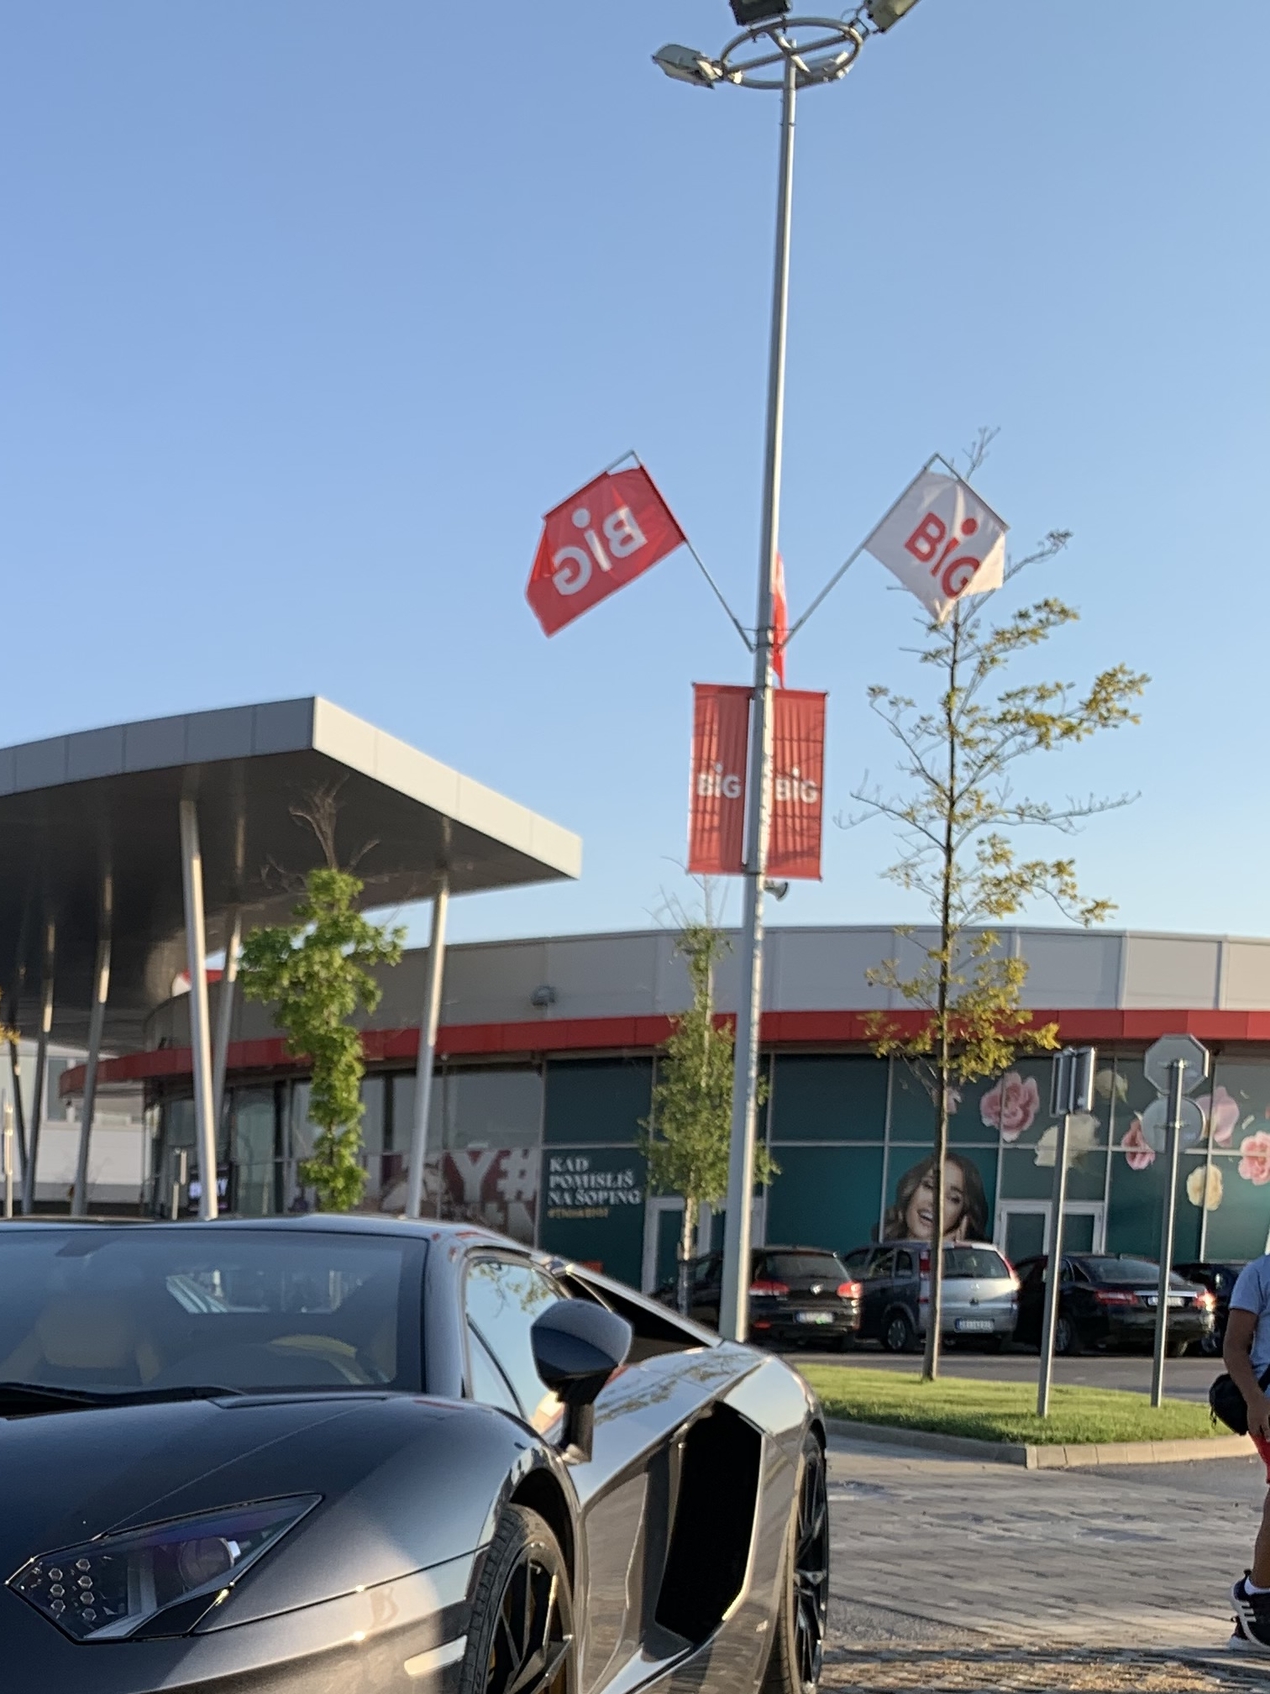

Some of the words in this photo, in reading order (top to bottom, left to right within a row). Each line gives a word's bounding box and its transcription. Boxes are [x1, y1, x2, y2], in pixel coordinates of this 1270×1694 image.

[550, 1157, 590, 1172] KAD
[549, 1169, 634, 1189] POMISLIŠ
[548, 1191, 573, 1206] NA
[575, 1188, 642, 1206] ŠOPING
